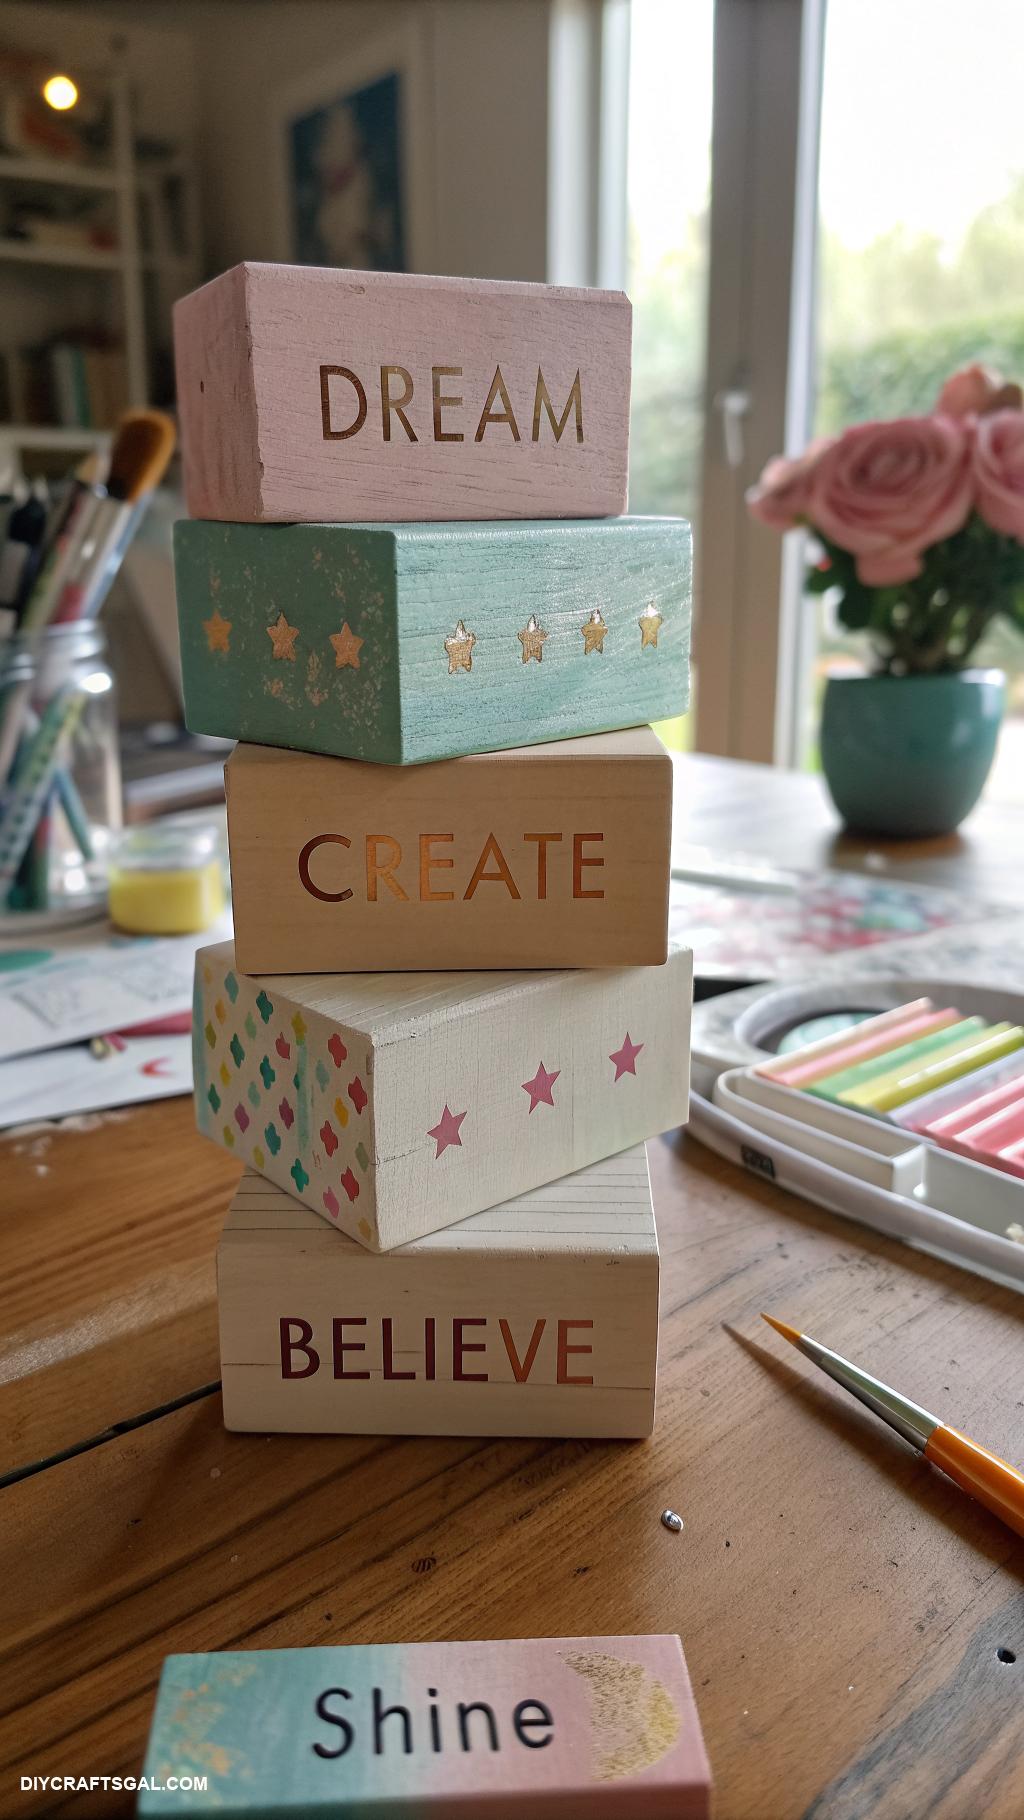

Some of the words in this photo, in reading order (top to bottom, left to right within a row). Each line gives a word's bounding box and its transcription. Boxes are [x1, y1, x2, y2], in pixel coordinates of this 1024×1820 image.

[319, 364, 584, 444] DREAM
[298, 832, 605, 902] CREATE
[279, 1316, 595, 1385] BELIEVE
[311, 1686, 555, 1760] Shine
